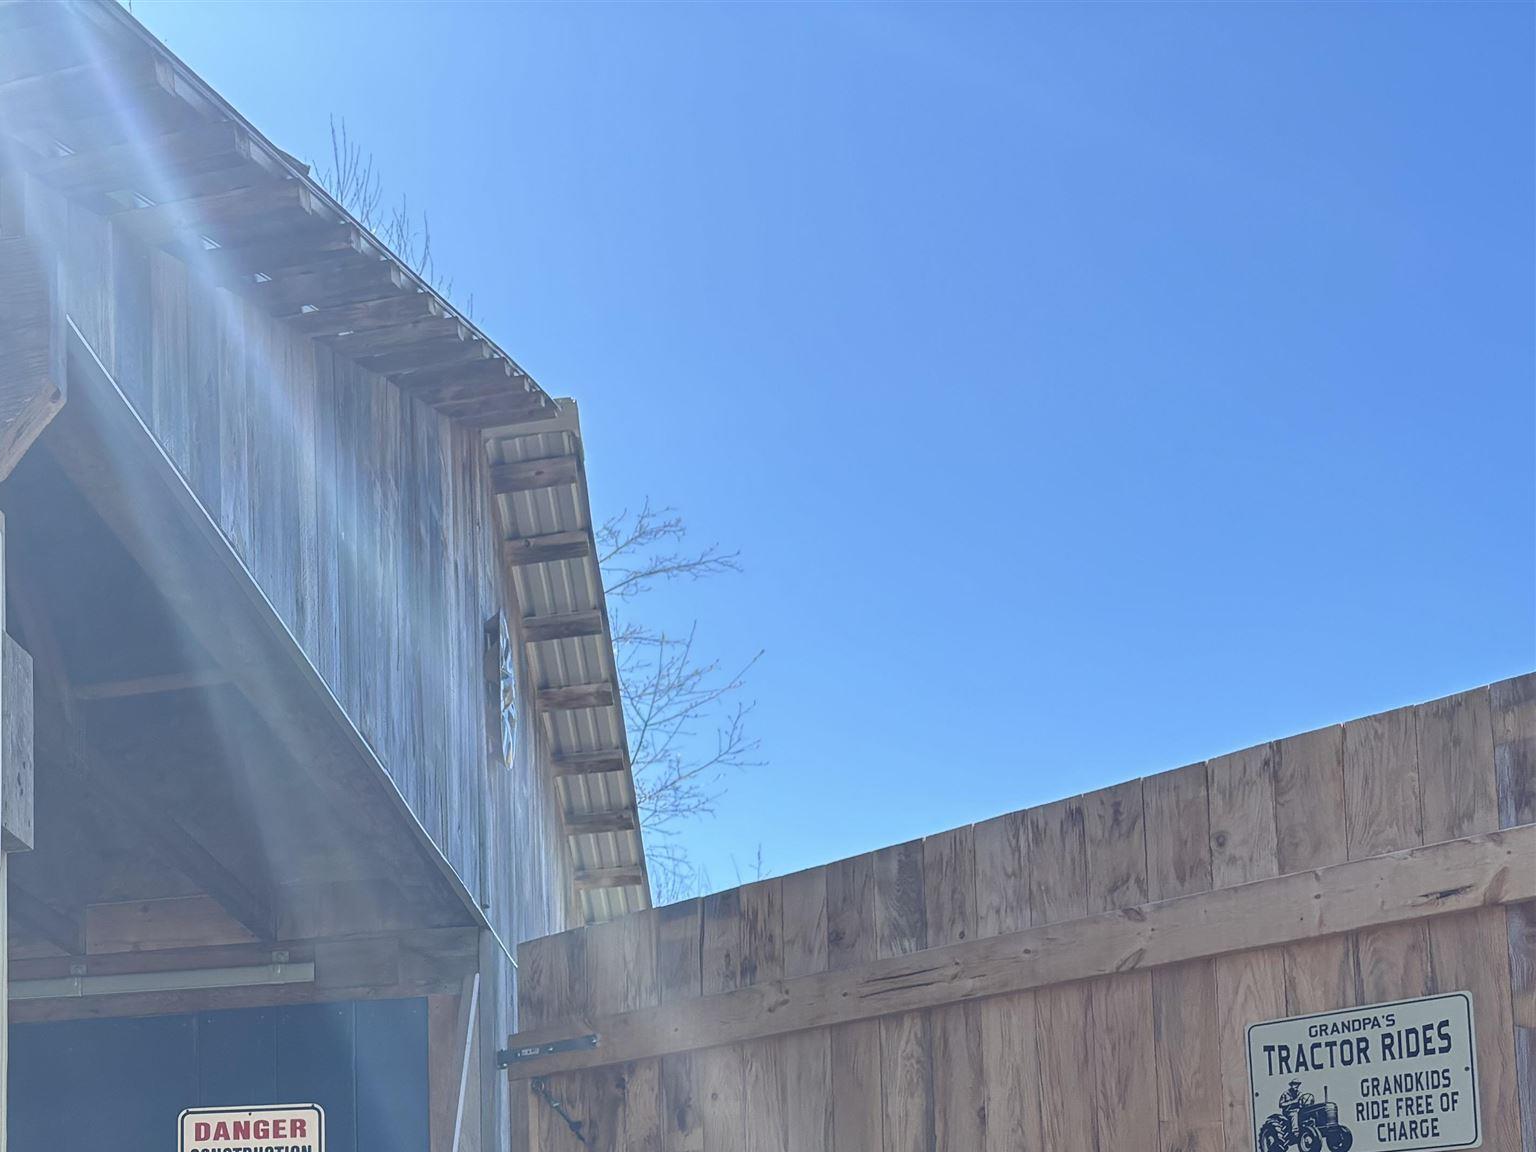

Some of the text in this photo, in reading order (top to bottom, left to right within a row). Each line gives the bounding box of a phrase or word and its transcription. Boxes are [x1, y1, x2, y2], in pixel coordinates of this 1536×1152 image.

[1308, 1013, 1396, 1038] GRANDPA'S
[1263, 1019, 1452, 1076] TRACTOR RIDES
[1360, 1068, 1451, 1098] GRANDKIDS
[1356, 1091, 1460, 1122] RIDE FREE OF
[194, 1118, 307, 1142] DANGER
[1377, 1118, 1440, 1143] CHARGE
